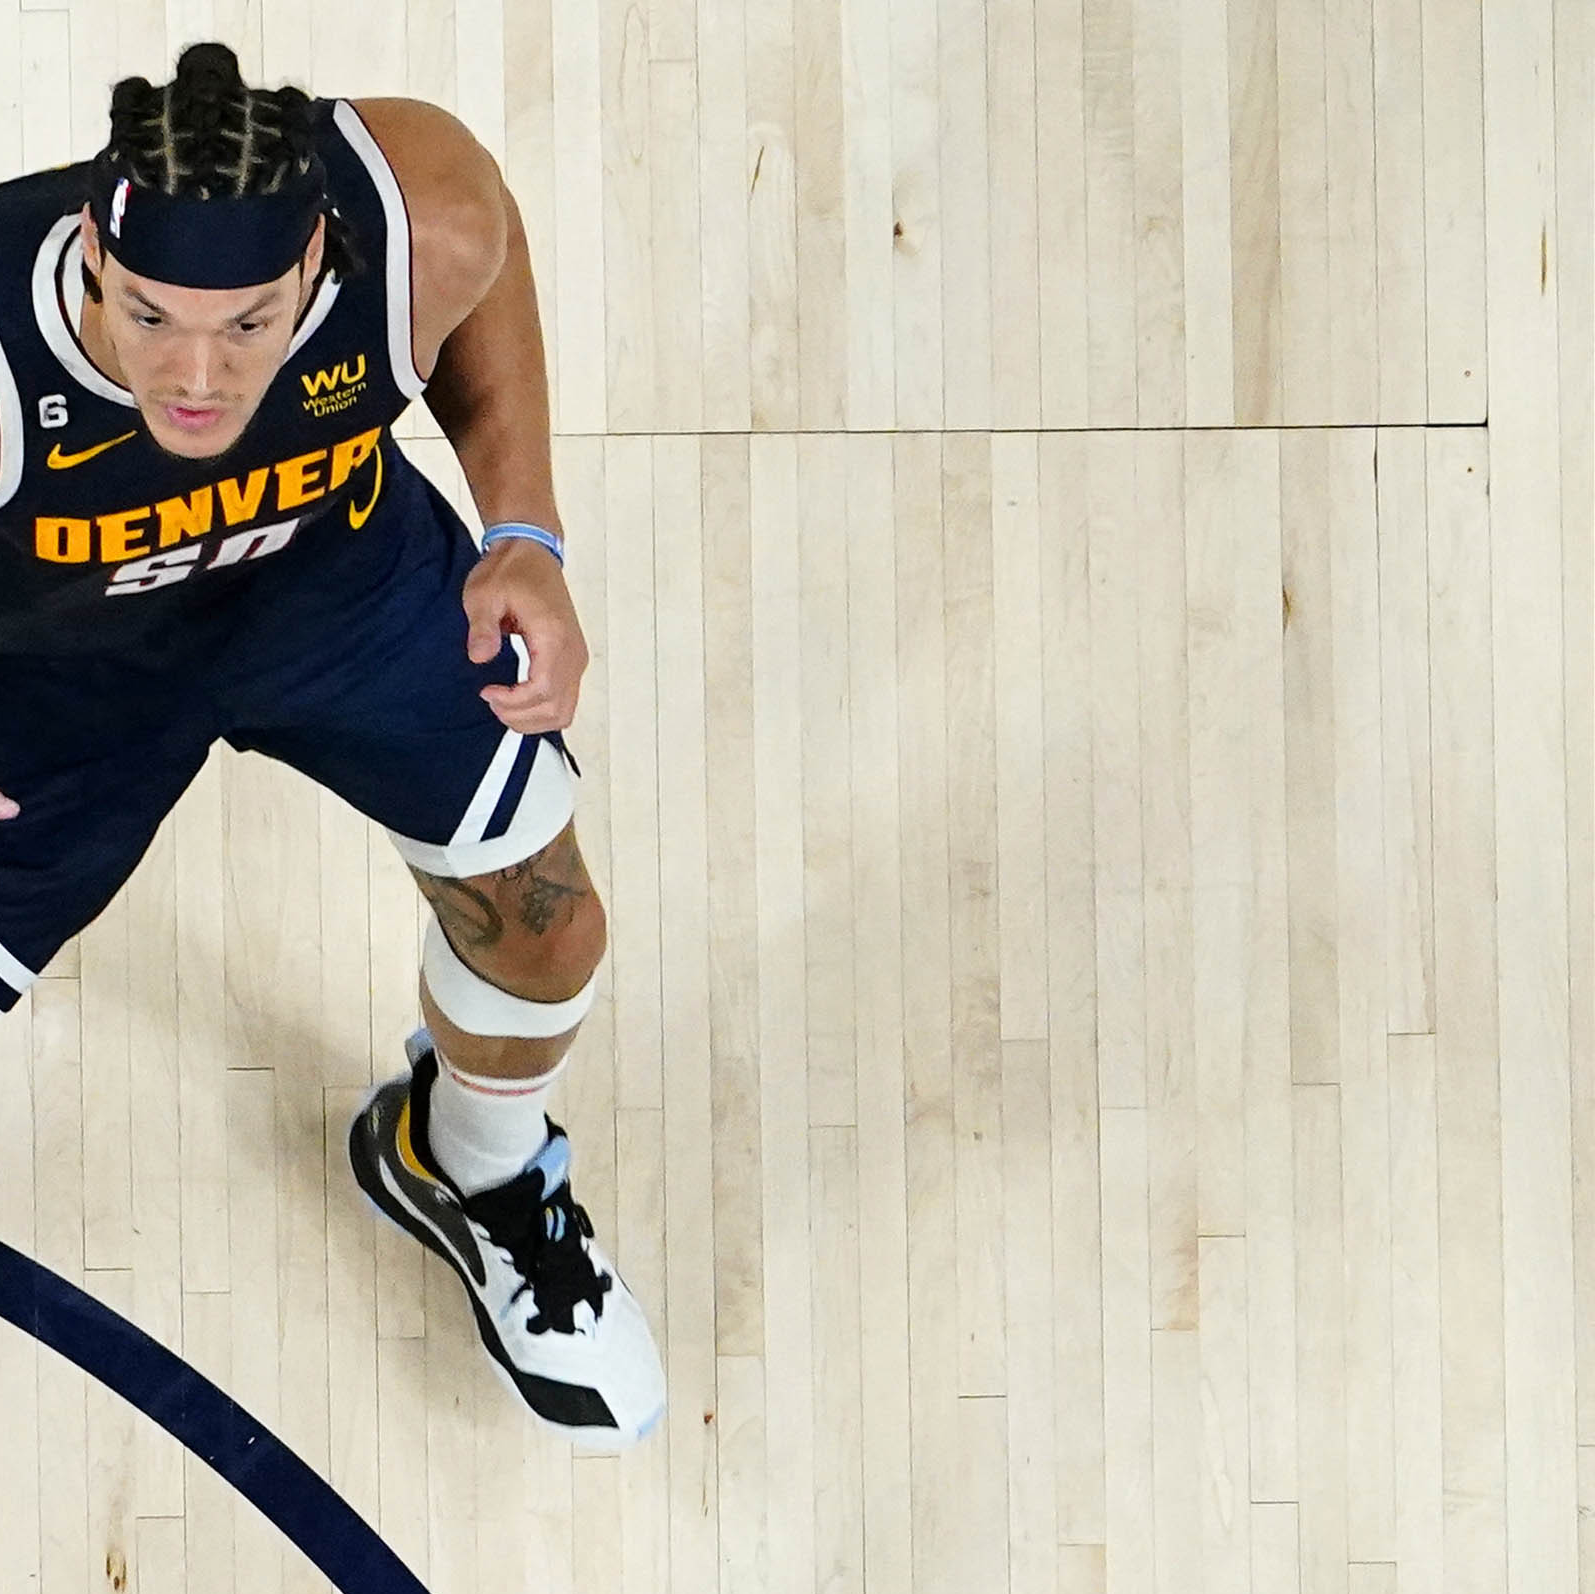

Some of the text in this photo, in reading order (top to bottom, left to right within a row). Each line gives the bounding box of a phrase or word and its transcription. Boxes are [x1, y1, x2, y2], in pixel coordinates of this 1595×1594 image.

[301, 353, 366, 397] WU
[38, 393, 69, 429] 6
[302, 382, 367, 411] Western
[314, 396, 357, 417] Union
[35, 426, 382, 564] DENVER
